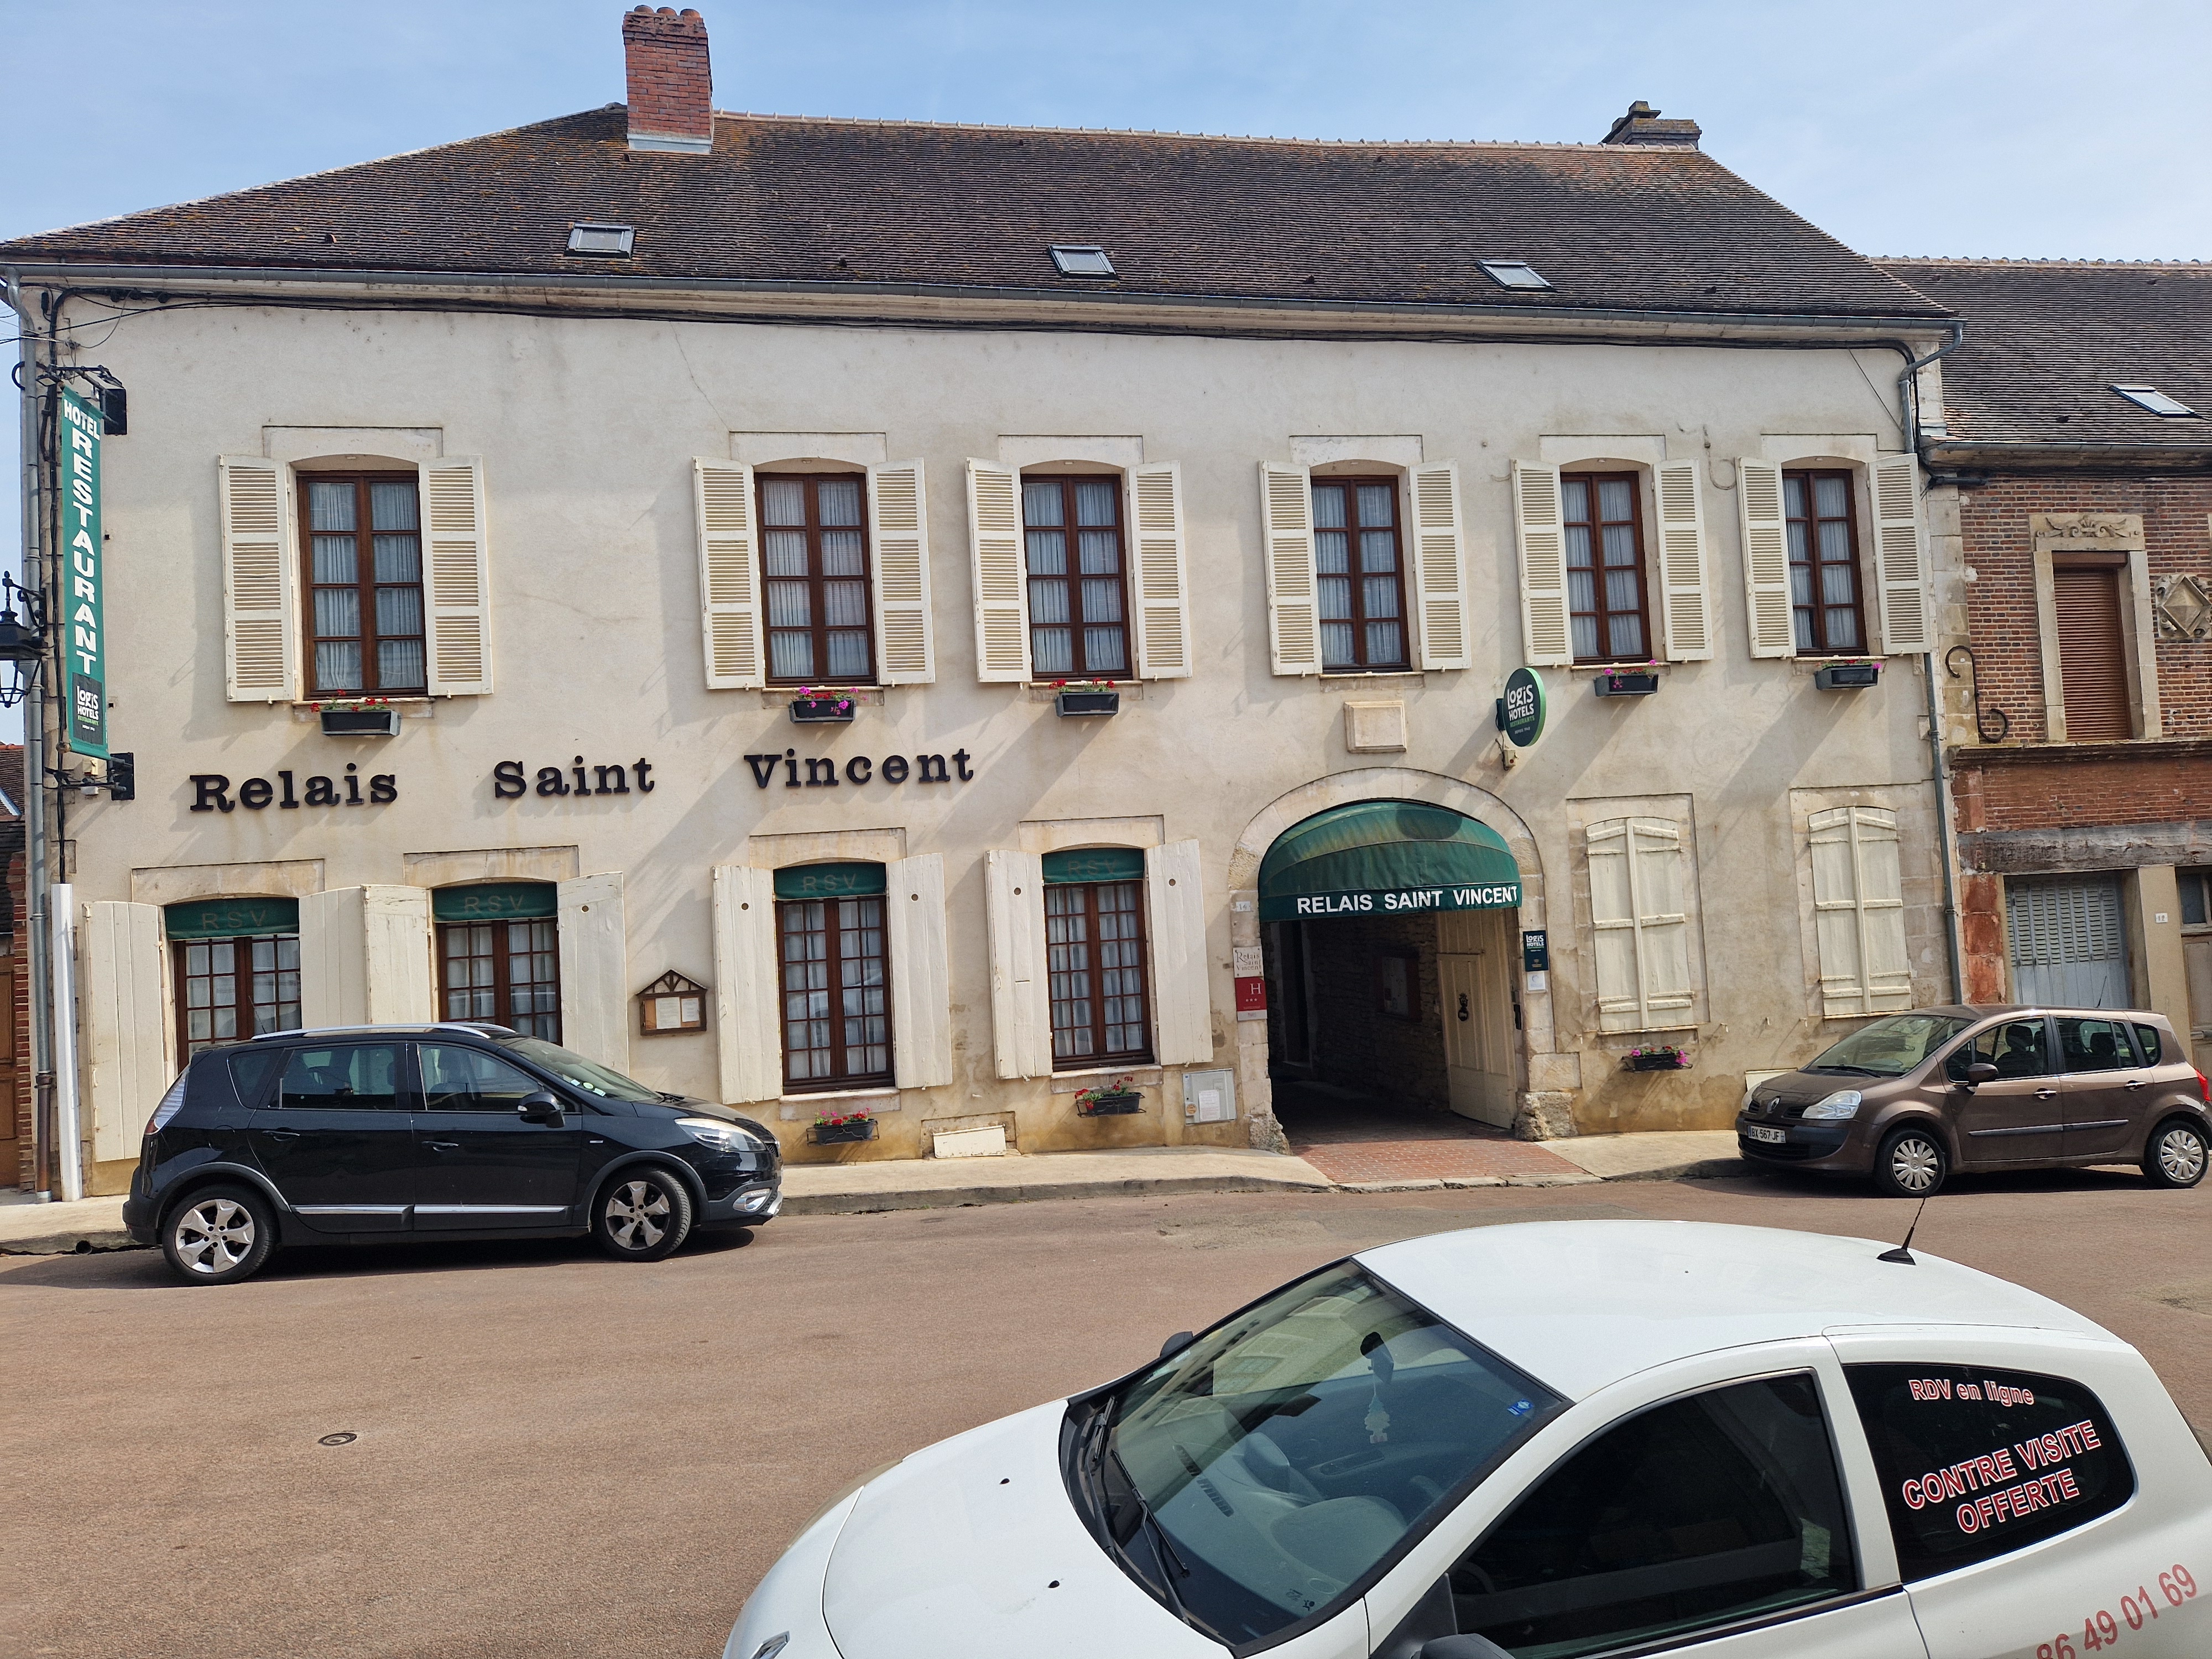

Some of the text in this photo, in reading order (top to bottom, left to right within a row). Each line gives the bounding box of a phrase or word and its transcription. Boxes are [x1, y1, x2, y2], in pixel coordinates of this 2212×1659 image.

[64, 399, 101, 441] HOTEL
[72, 427, 95, 674] RESTAURANT
[77, 705, 99, 721] HOTELS
[1509, 703, 1535, 721] HOTELS
[189, 748, 974, 813] Relais Saint Vincent
[1067, 859, 1118, 876] RSV
[802, 874, 857, 893] RSV
[463, 894, 525, 914] RSV
[1297, 885, 1519, 914] RELAIS SAINT VINCENT
[201, 910, 268, 930] RSV
[1235, 951, 1260, 962] Relais
[1250, 983, 1261, 995] H
[1908, 1379, 2034, 1407] RDV en ligne
[1902, 1420, 2101, 1510] CONTRE VISITE
[1957, 1468, 2080, 1535] OFFERTE
[2084, 1610, 2119, 1652] 49
[2120, 1585, 2159, 1631] 01
[2158, 1564, 2198, 1607] 69
